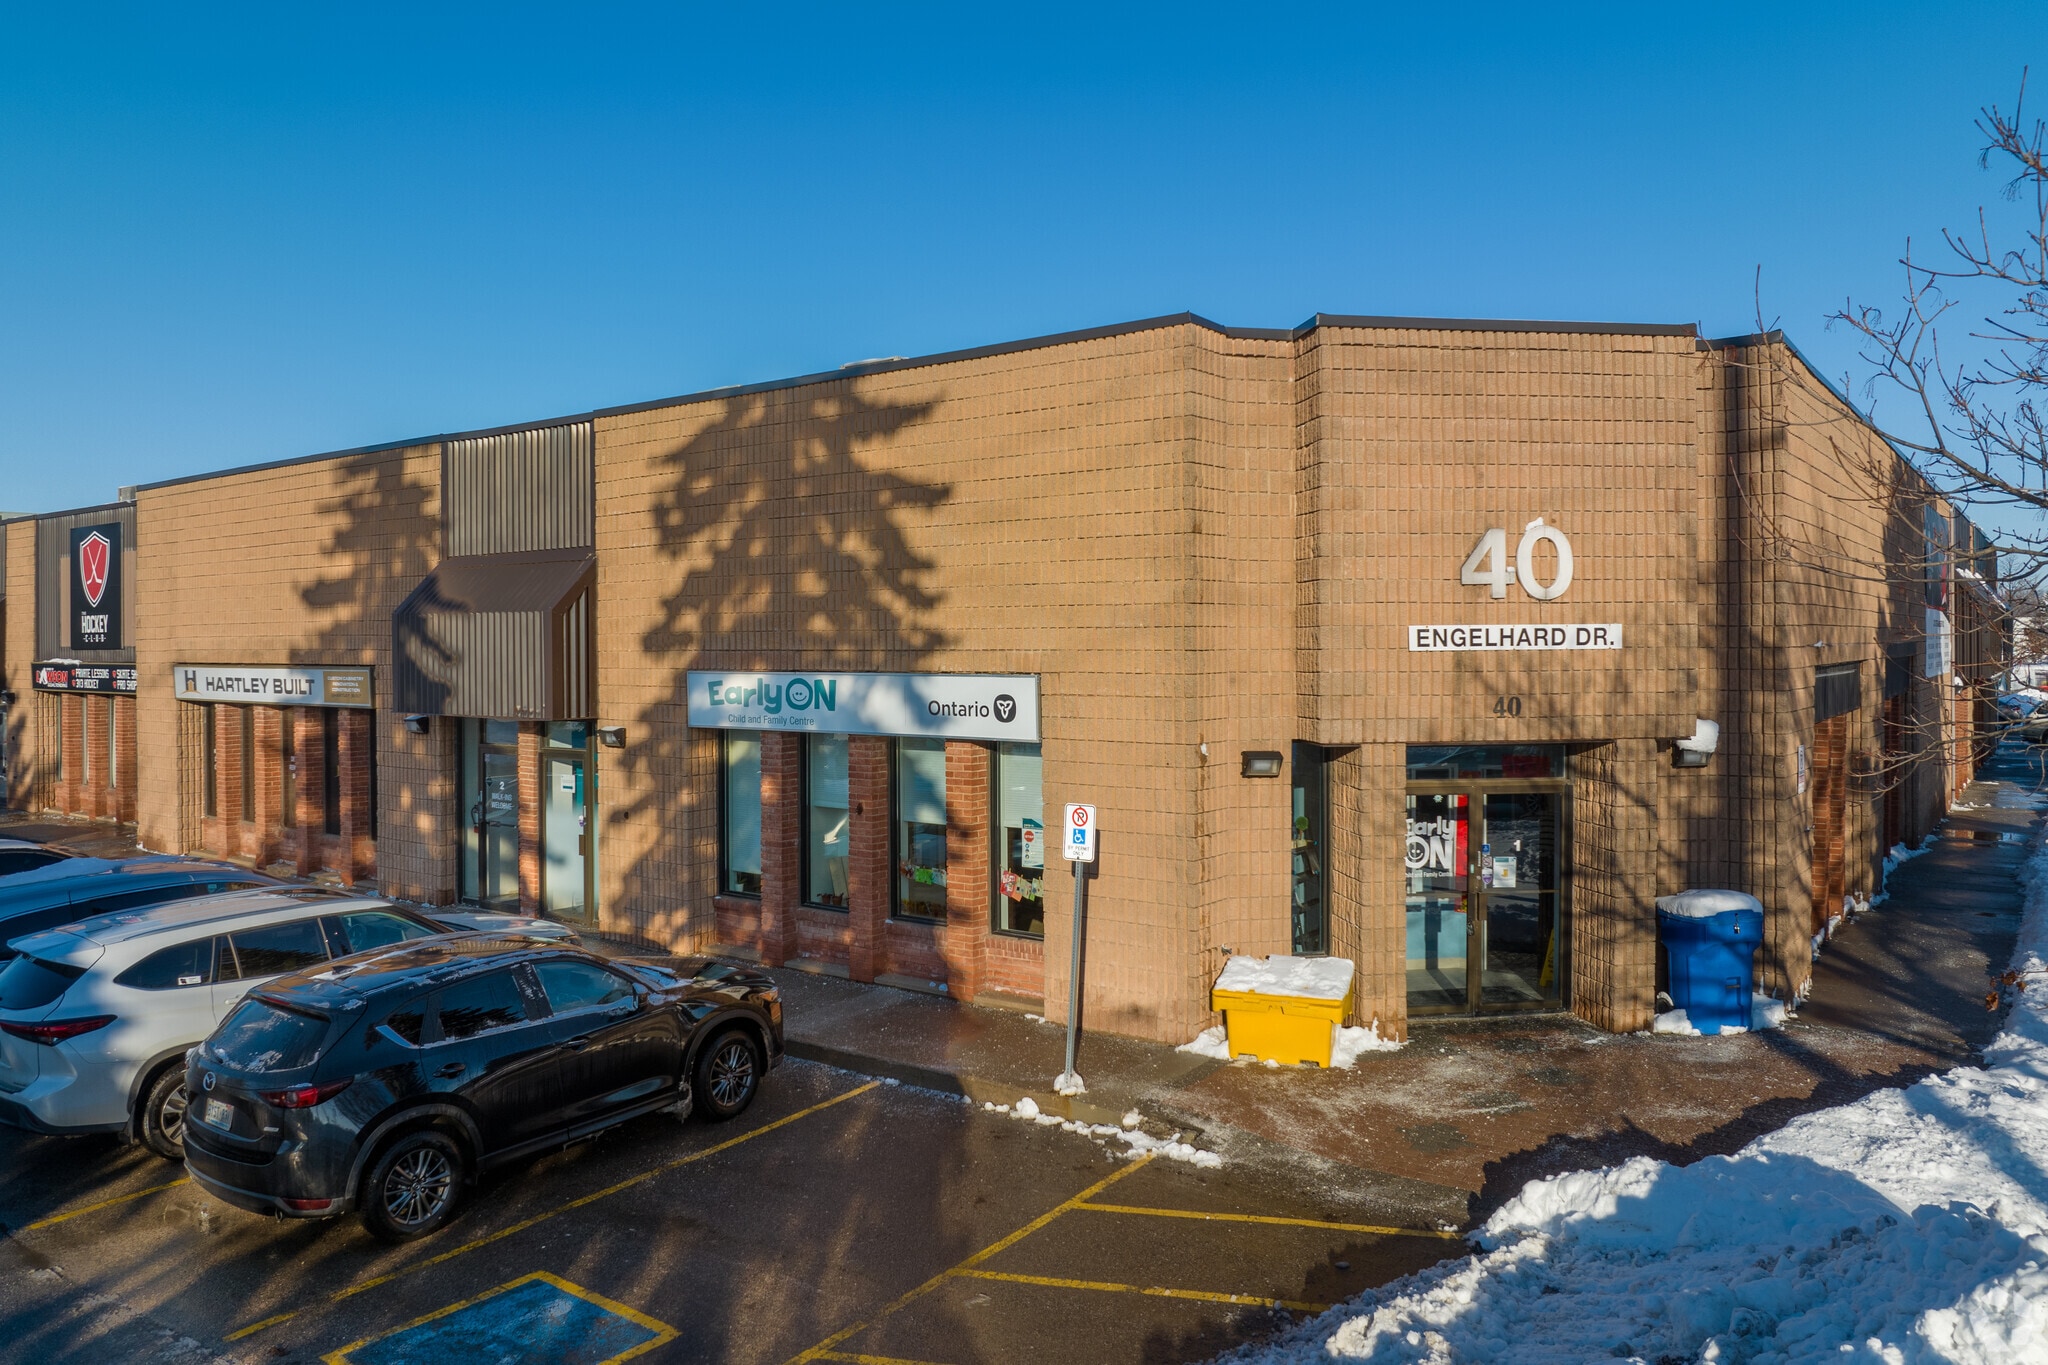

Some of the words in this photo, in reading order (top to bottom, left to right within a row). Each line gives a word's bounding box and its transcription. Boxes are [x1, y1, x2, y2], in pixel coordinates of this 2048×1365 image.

[1460, 525, 1574, 601] 40
[81, 614, 108, 633] HOCKEY
[1416, 627, 1567, 648] ENGELHARD
[1575, 626, 1616, 646] DR.
[75, 668, 91, 679] PRIVATE
[92, 668, 109, 679] LESSONS
[116, 669, 131, 680] SKATE
[83, 679, 99, 689] HOCKEY
[116, 680, 126, 690] PRO
[205, 676, 270, 694] HARTLEY
[272, 678, 316, 696] BUILT
[928, 699, 990, 718] Ontario
[1492, 696, 1522, 719] 40
[727, 713, 746, 723] Child
[747, 715, 762, 724] and
[763, 715, 788, 726] Family
[789, 715, 815, 726] Centre
[499, 781, 505, 790] 2
[1513, 839, 1521, 852] 1
